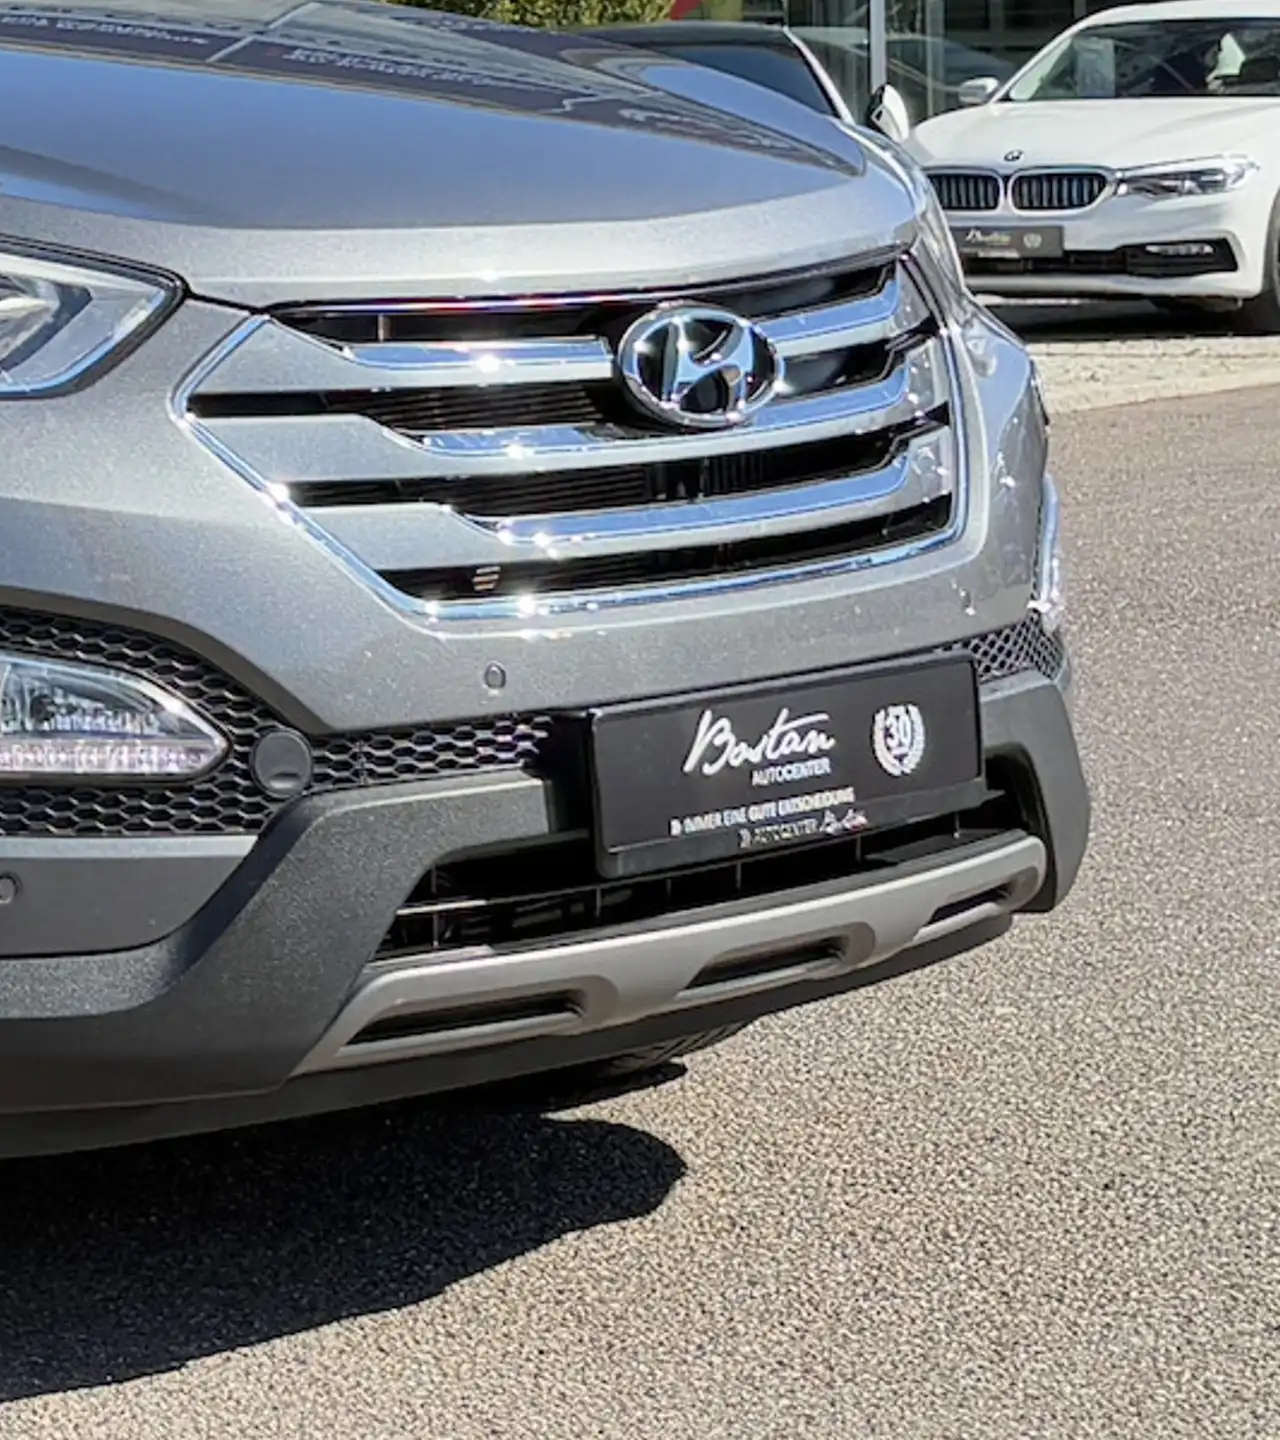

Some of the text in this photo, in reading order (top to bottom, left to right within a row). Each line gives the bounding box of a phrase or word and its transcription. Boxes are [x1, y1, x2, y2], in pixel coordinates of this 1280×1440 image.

[682, 706, 837, 777] Bostan
[885, 713, 911, 748] 30
[751, 757, 832, 787] AUTOCENTER
